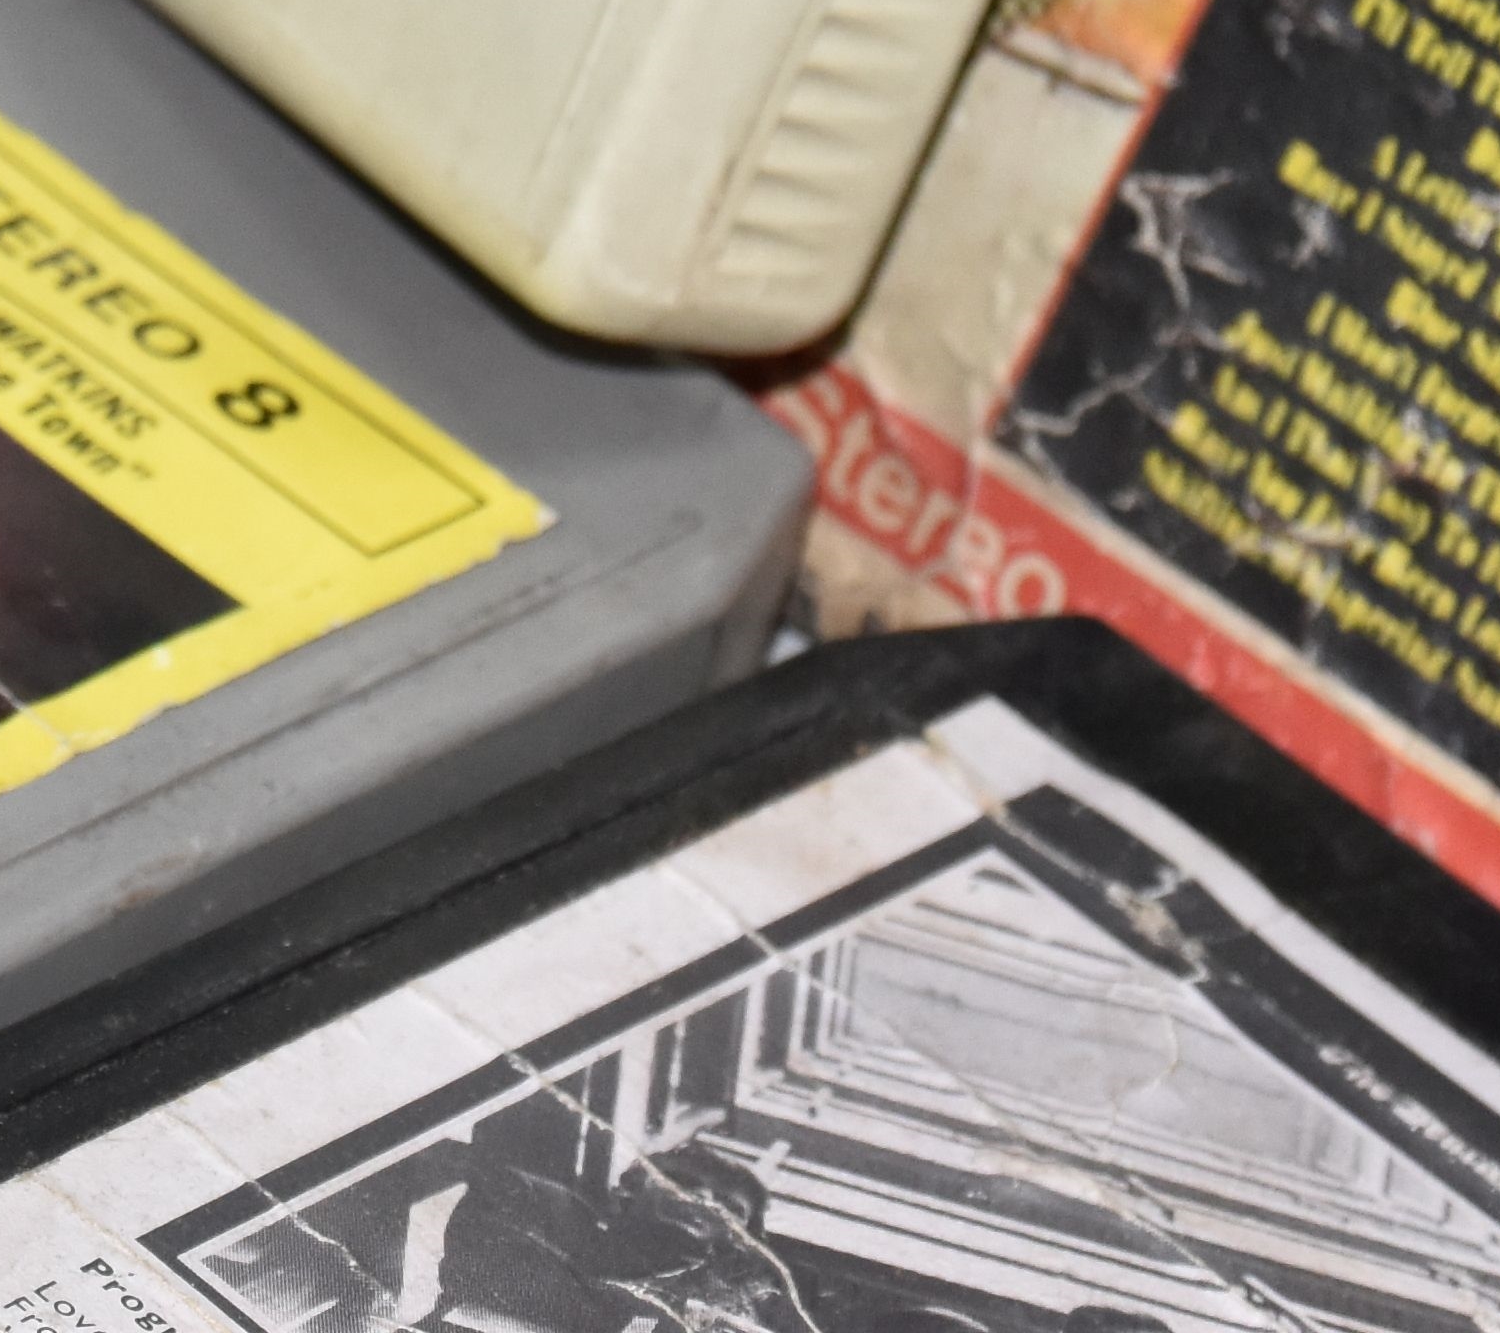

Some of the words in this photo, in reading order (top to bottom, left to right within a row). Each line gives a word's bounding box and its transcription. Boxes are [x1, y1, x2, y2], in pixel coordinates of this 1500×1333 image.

[215, 378, 303, 431] 8
[775, 377, 1066, 620] Stereo
[34, 1281, 105, 1333] Lov
